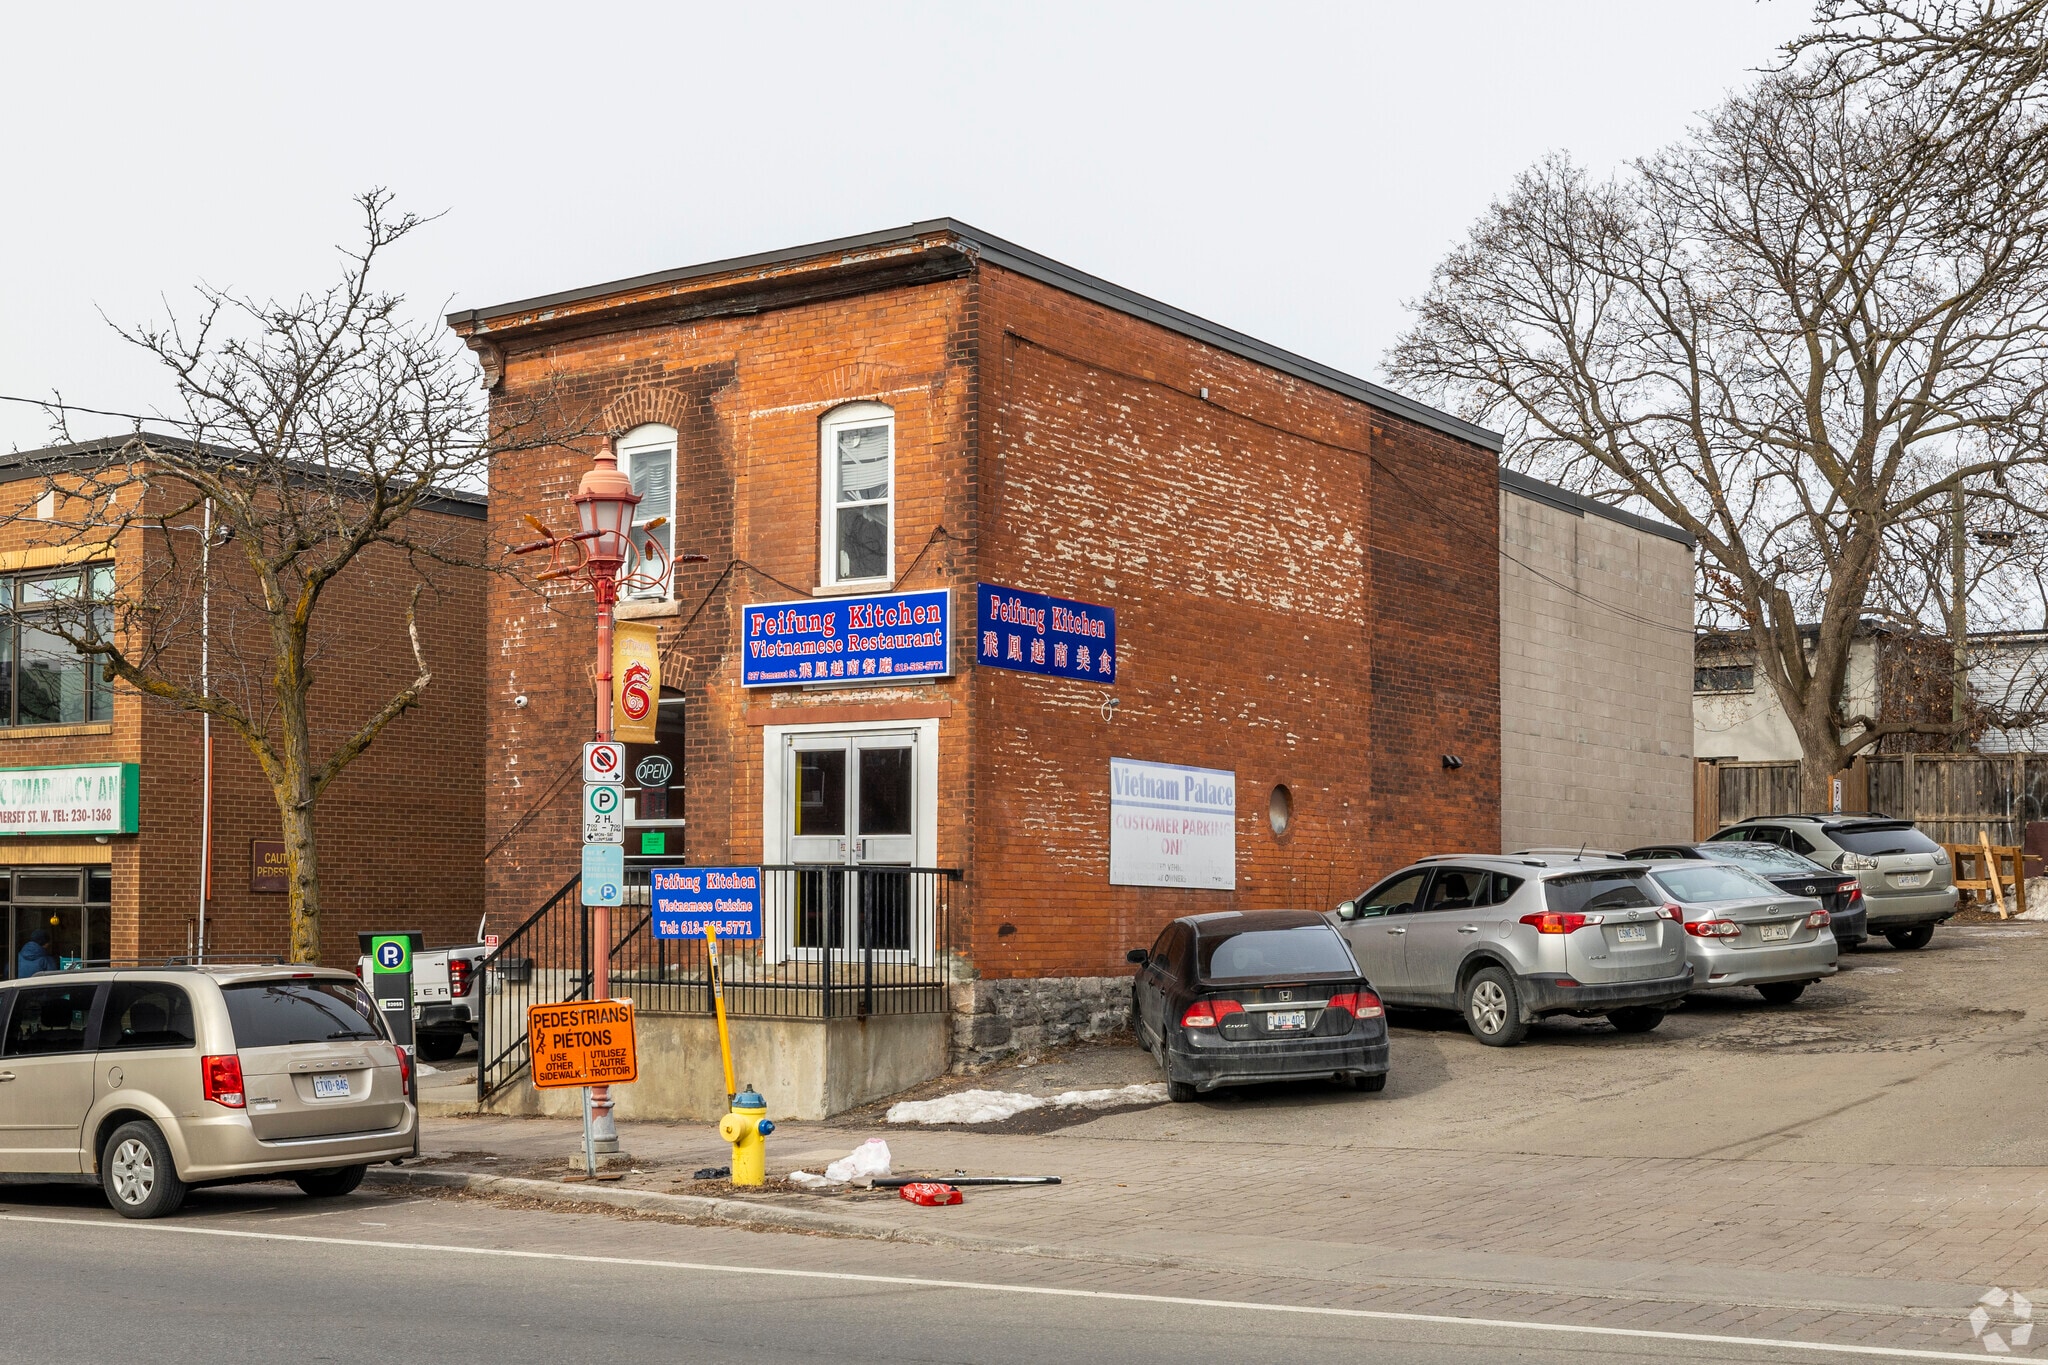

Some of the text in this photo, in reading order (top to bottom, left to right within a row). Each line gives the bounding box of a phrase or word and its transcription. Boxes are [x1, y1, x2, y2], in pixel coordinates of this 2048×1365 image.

[751, 600, 942, 638] Feifung Kitchen
[990, 594, 1106, 639] Feifung Kitchen
[750, 628, 943, 658] Vietnamese Restaurant
[638, 763, 670, 779] OPEN
[1113, 767, 1233, 806] Vietnam Palace
[27, 810, 38, 823] ST.
[40, 810, 51, 822] W.
[53, 809, 69, 822] TEL:
[71, 808, 112, 822] 230-1368
[595, 814, 601, 823] 2
[1115, 814, 1231, 837] CUSTOMER PARKING
[655, 872, 756, 893] Feifung Kitchen
[658, 898, 753, 913] Vietnamese Cuisine
[660, 920, 679, 935] Tel:
[533, 1006, 629, 1029] PEDESTRIANS
[553, 1029, 612, 1049] PIÉTONS
[550, 1053, 568, 1062] USE
[590, 1048, 627, 1058] UTILISEZ
[546, 1062, 574, 1071] OTHER
[592, 1057, 626, 1068] L'AUTRE
[539, 1070, 581, 1081] SIDEWALK
[590, 1066, 631, 1077] TROTTOIR
